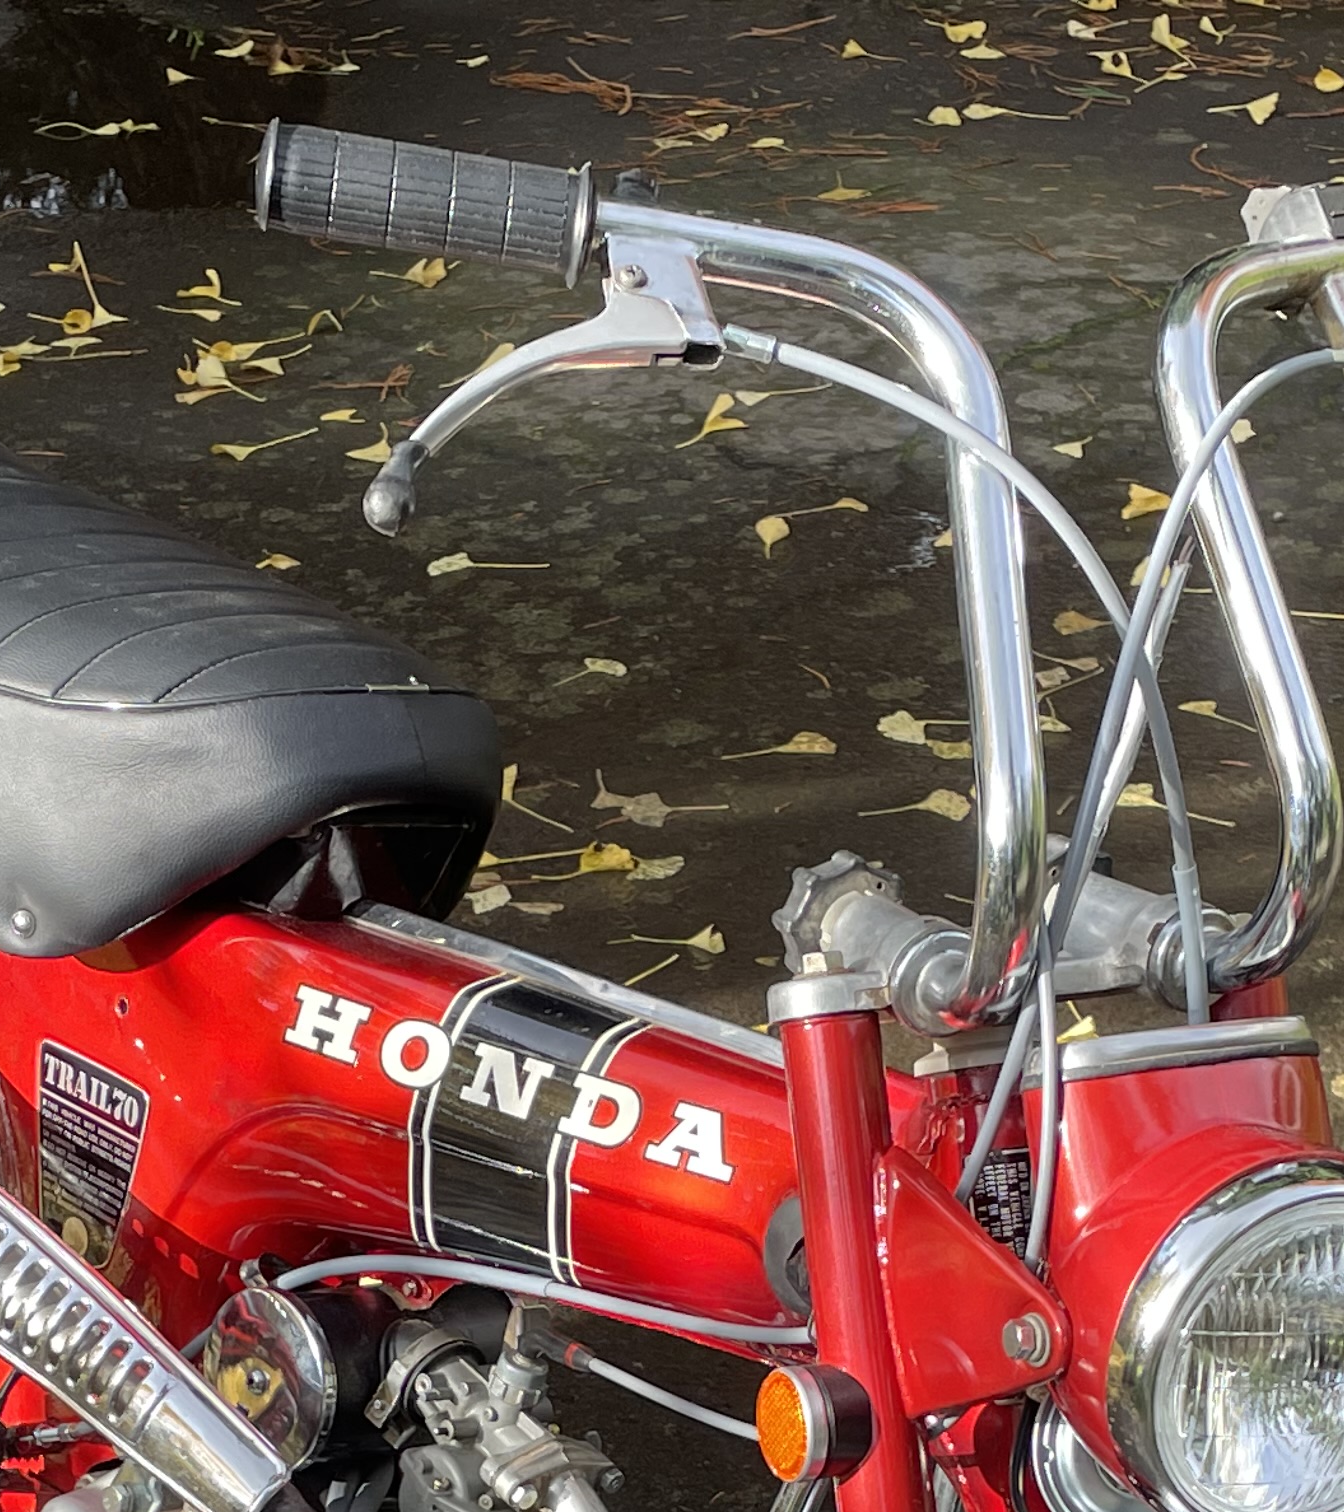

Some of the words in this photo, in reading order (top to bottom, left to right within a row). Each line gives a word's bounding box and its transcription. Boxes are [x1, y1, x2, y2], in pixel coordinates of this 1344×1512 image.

[283, 984, 736, 1184] HONDA
[983, 1165, 997, 1197] EFFECT
[994, 1163, 1008, 1201] FEDERAL
[1000, 1207, 1013, 1238] MOTOR
